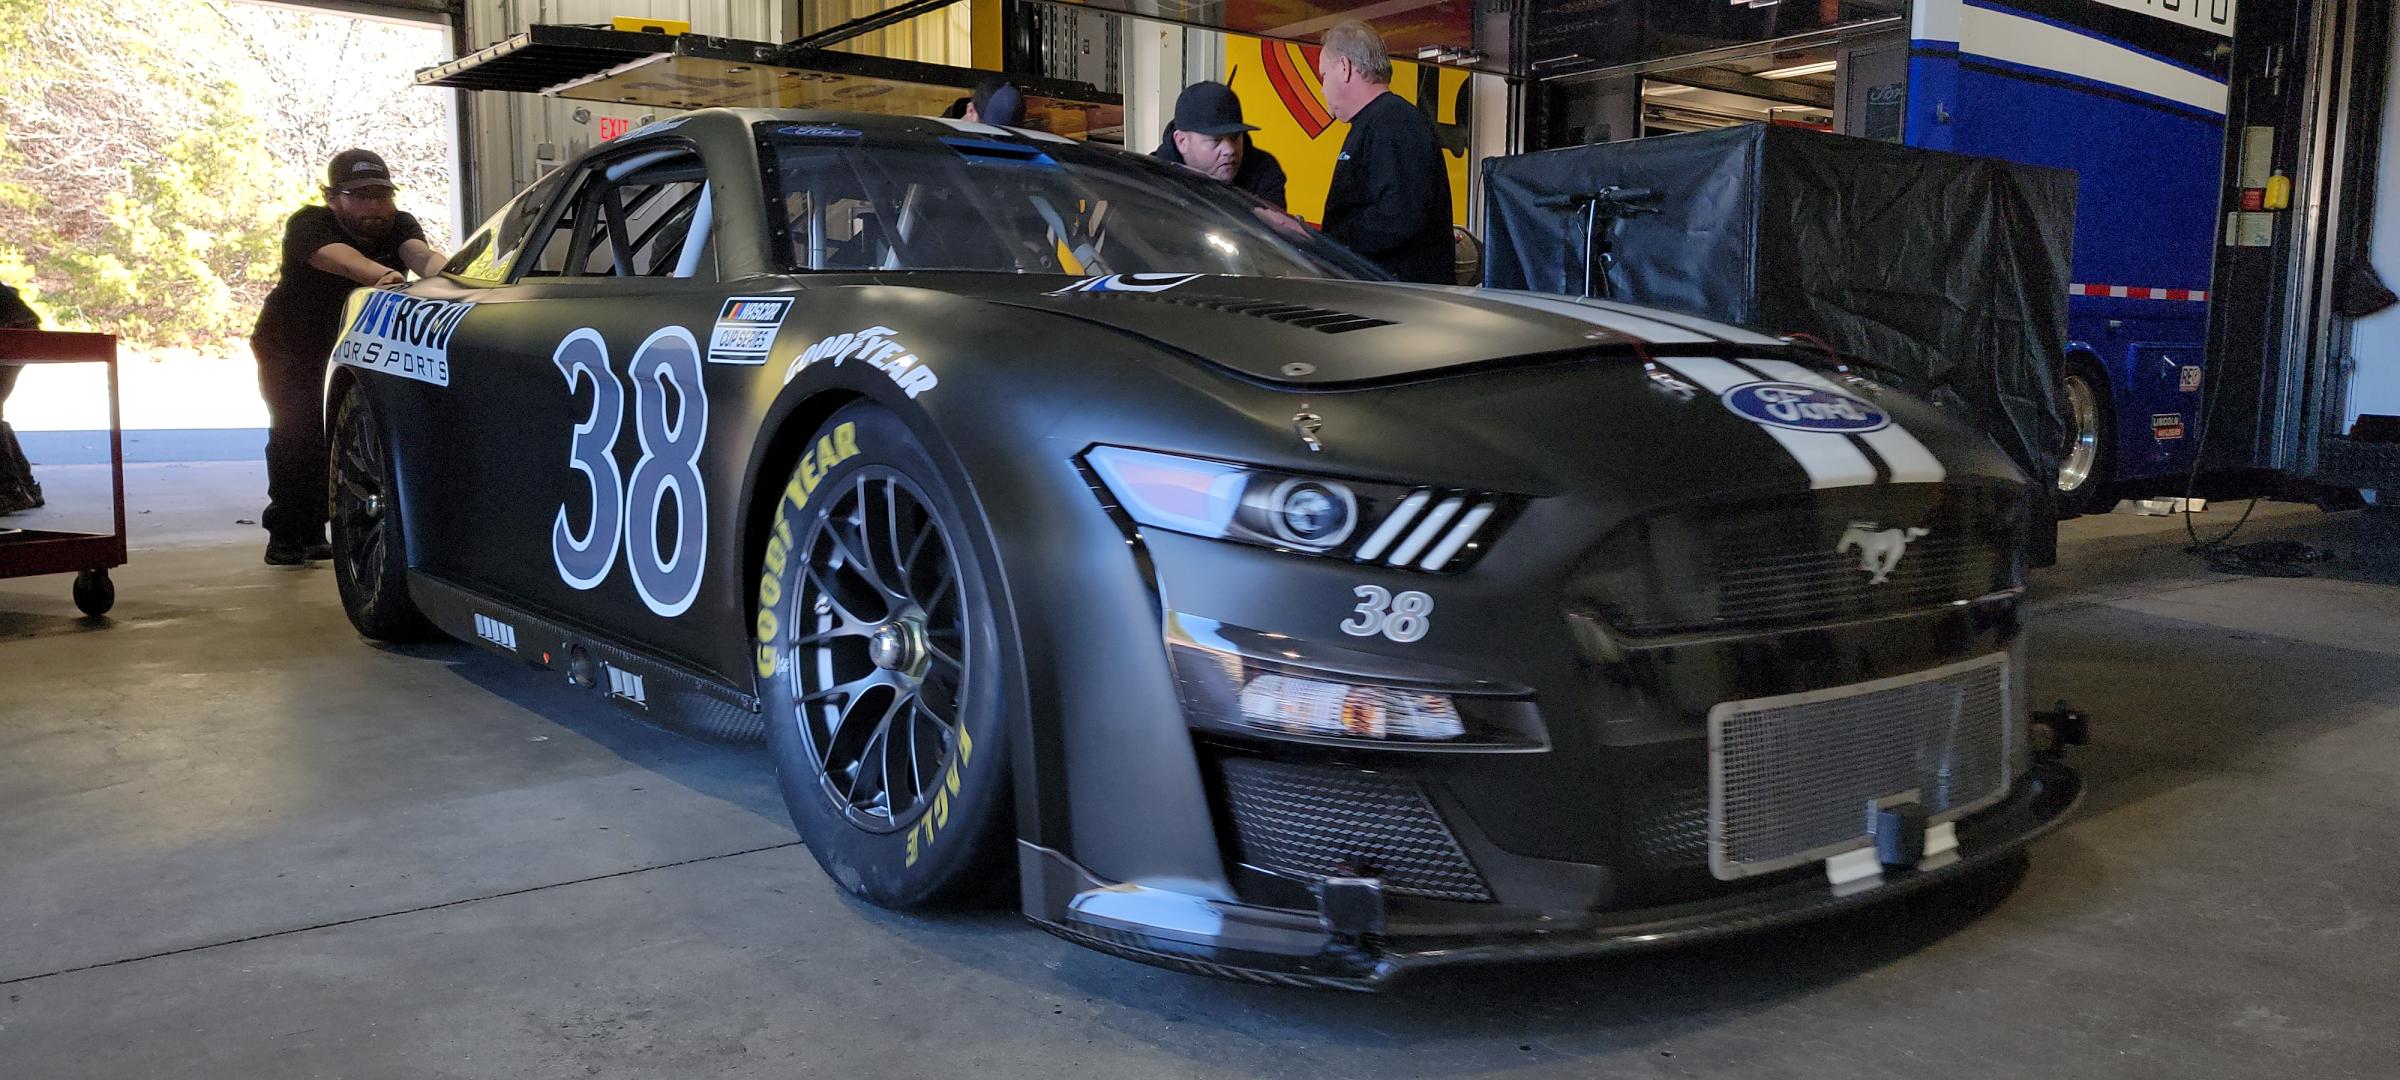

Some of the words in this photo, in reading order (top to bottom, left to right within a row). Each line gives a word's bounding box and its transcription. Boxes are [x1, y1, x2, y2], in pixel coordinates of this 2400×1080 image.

[600, 117, 629, 141] EXIT
[354, 291, 472, 350] NTROW
[737, 302, 783, 321] NASCAR
[333, 340, 448, 381] ORSPORTS
[1753, 387, 1868, 422] Ford
[552, 325, 708, 618] 38
[1340, 584, 1435, 643] 38
[905, 719, 974, 869] EAGLE
